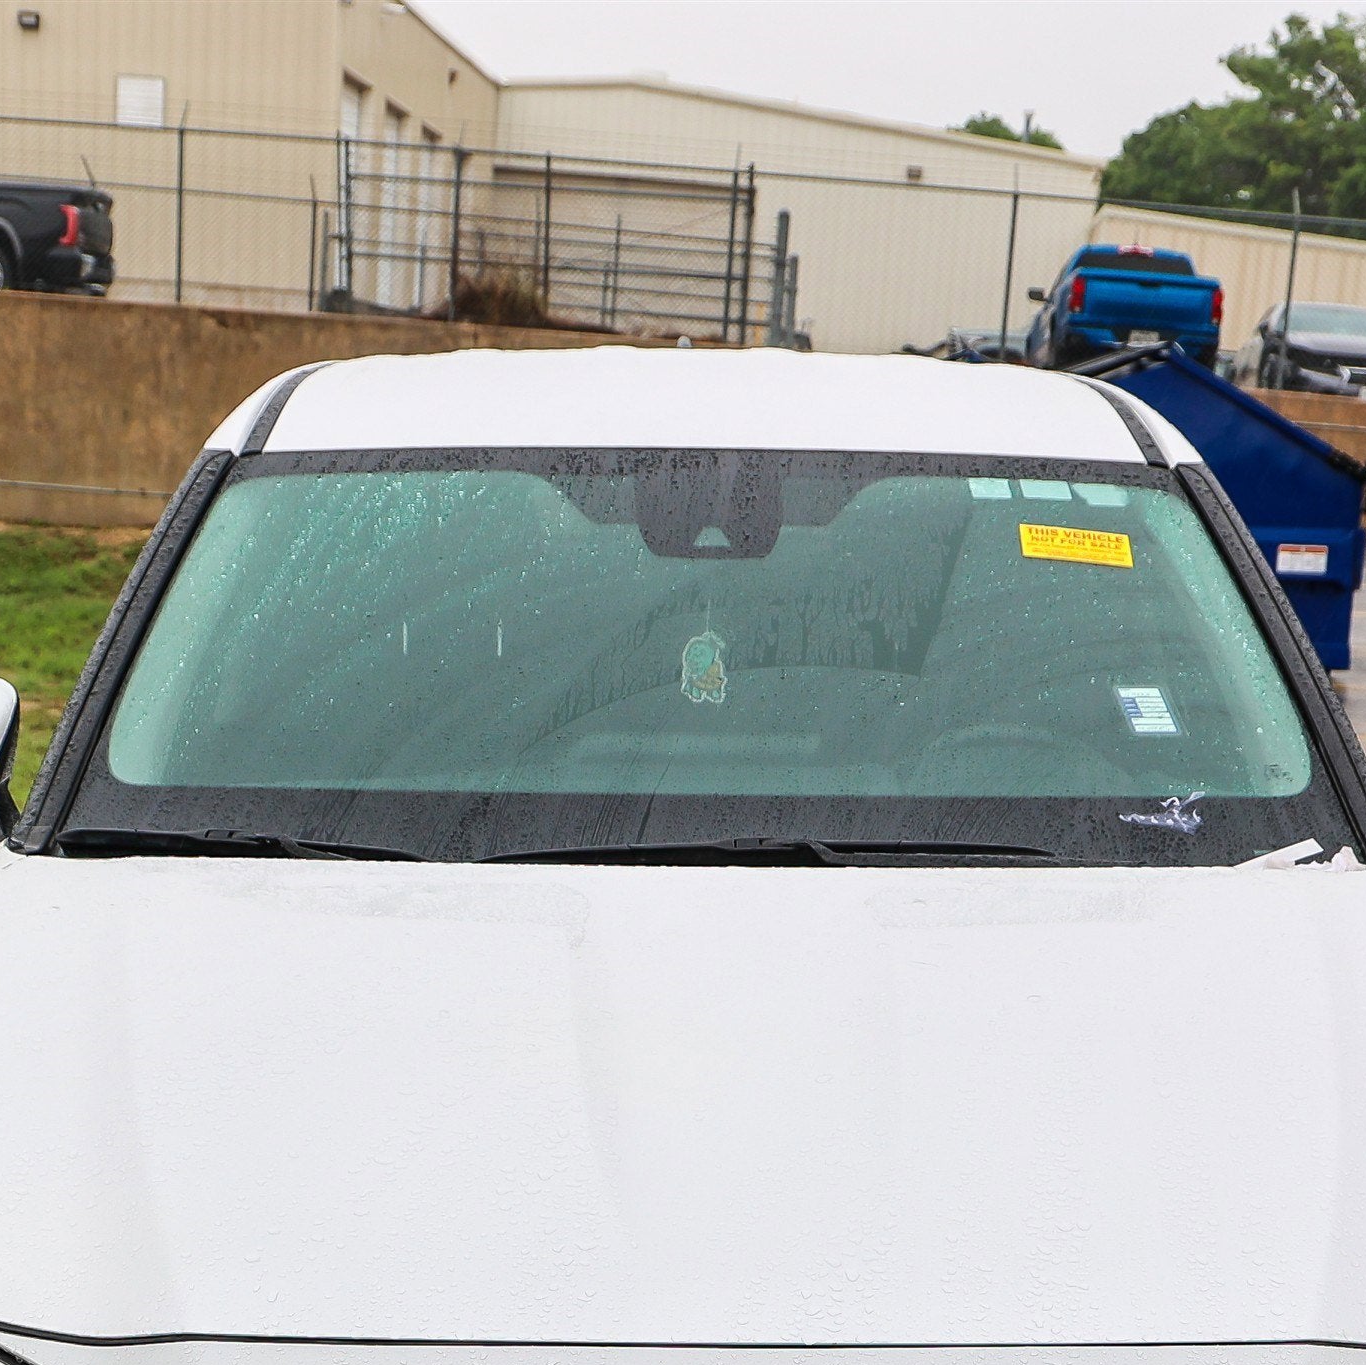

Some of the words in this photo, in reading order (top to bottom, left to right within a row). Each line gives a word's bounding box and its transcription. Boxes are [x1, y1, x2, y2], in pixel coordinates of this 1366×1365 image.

[1027, 527, 1059, 536] THIS
[1063, 530, 1124, 543] VEHICLE
[1031, 535, 1055, 543] NOT
[1060, 538, 1086, 546] FOR
[1090, 541, 1123, 550] SALE
